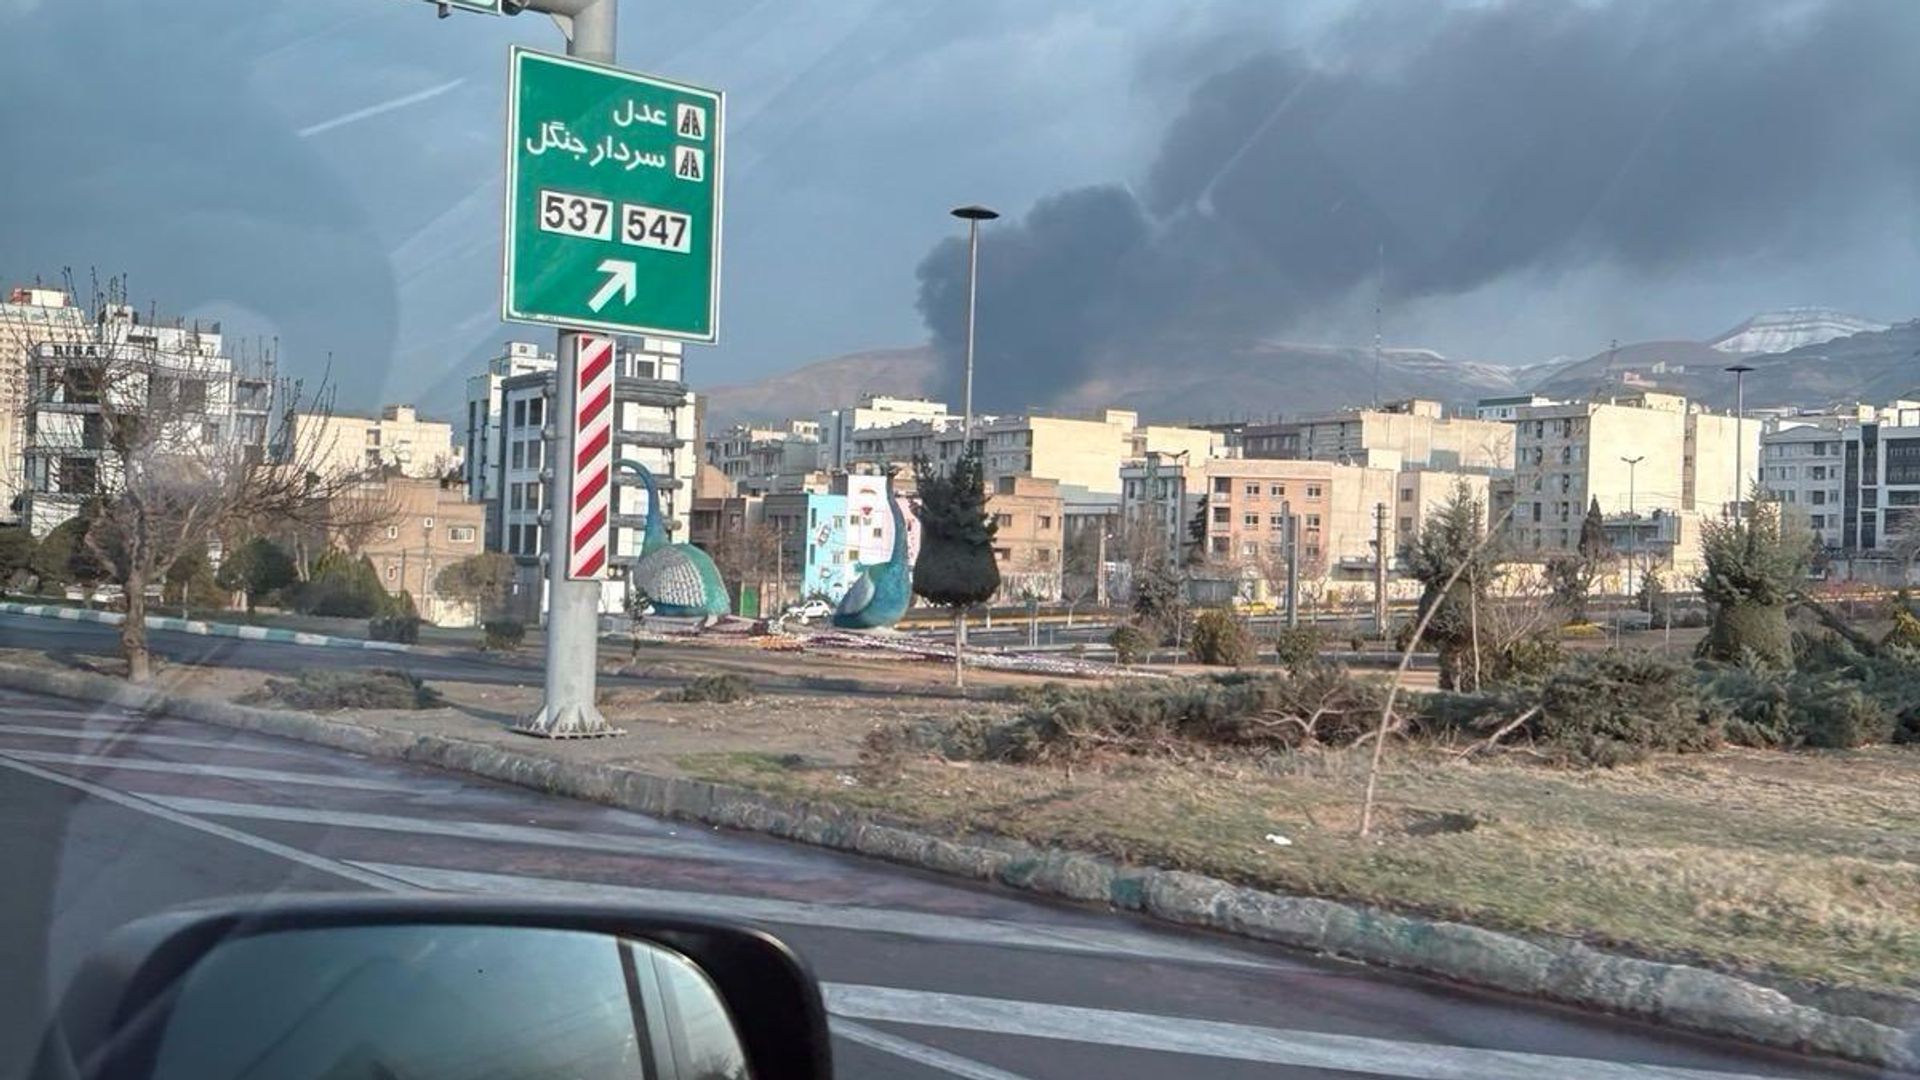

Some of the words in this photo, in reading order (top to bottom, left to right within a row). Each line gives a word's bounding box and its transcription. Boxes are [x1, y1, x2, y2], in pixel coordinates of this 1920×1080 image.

[613, 99, 667, 127] عدل
[526, 121, 588, 160] جنگل
[589, 135, 666, 171] سردار
[545, 196, 608, 234] 537
[627, 210, 687, 248] 547
